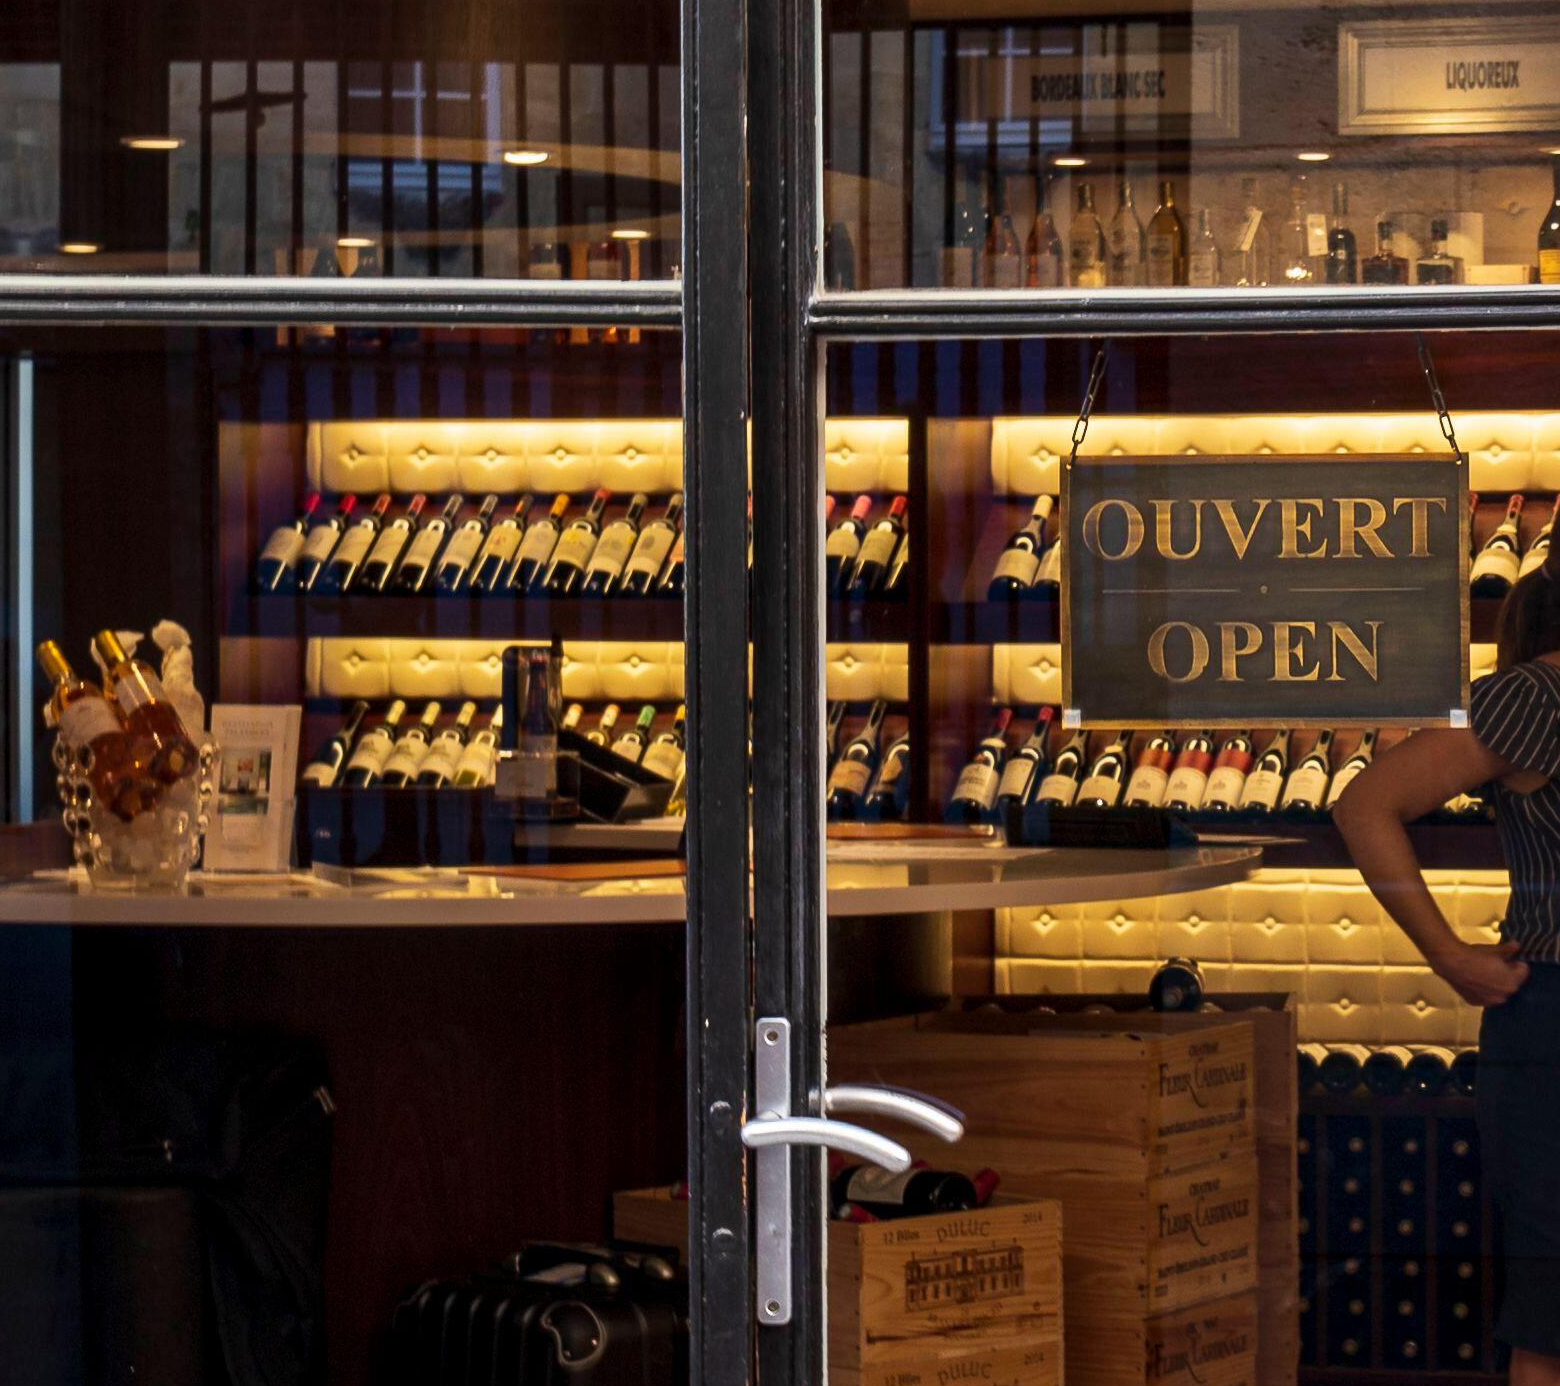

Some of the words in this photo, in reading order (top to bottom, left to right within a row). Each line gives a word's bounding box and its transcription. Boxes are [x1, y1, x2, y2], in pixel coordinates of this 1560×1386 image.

[1032, 73, 1097, 101] BORDEAUX
[1100, 71, 1140, 99] BLANC
[1144, 70, 1165, 98] SEC
[1446, 61, 1519, 91] LIQUOREUX
[1082, 497, 1447, 561] OUVERT
[1147, 620, 1384, 683] OPEN
[935, 1219, 991, 1243] DULUC
[937, 1361, 992, 1386] DULUC
